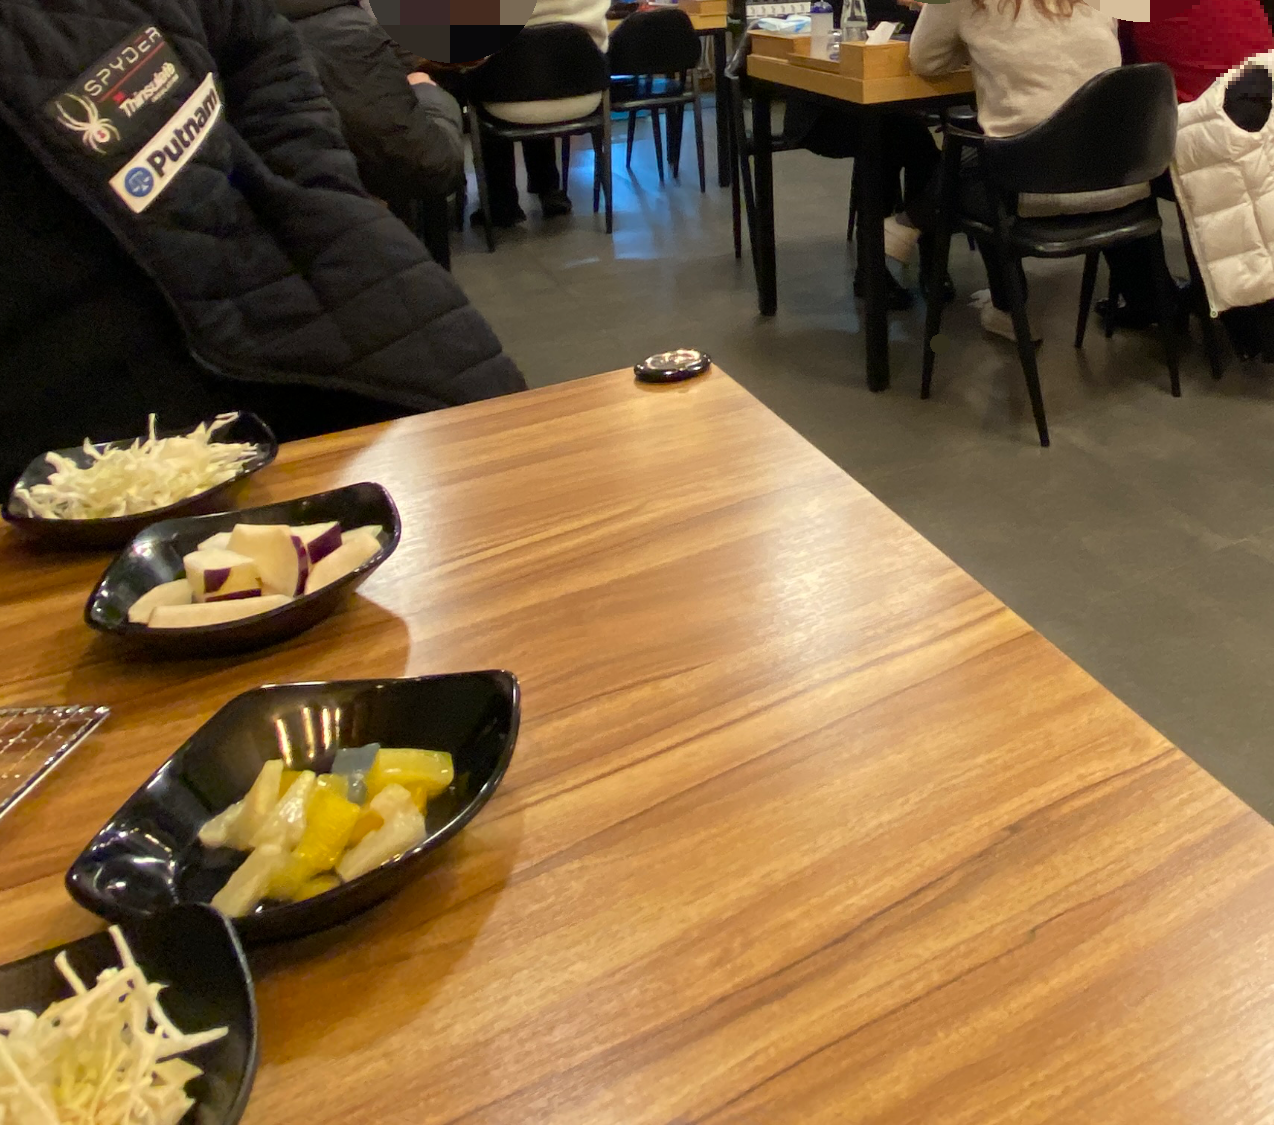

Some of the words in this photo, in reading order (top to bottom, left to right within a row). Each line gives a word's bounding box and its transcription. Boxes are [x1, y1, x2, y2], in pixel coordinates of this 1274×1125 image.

[83, 26, 163, 97] SPYDER
[118, 61, 176, 118] Thinsulate
[147, 87, 219, 178] Putnam
